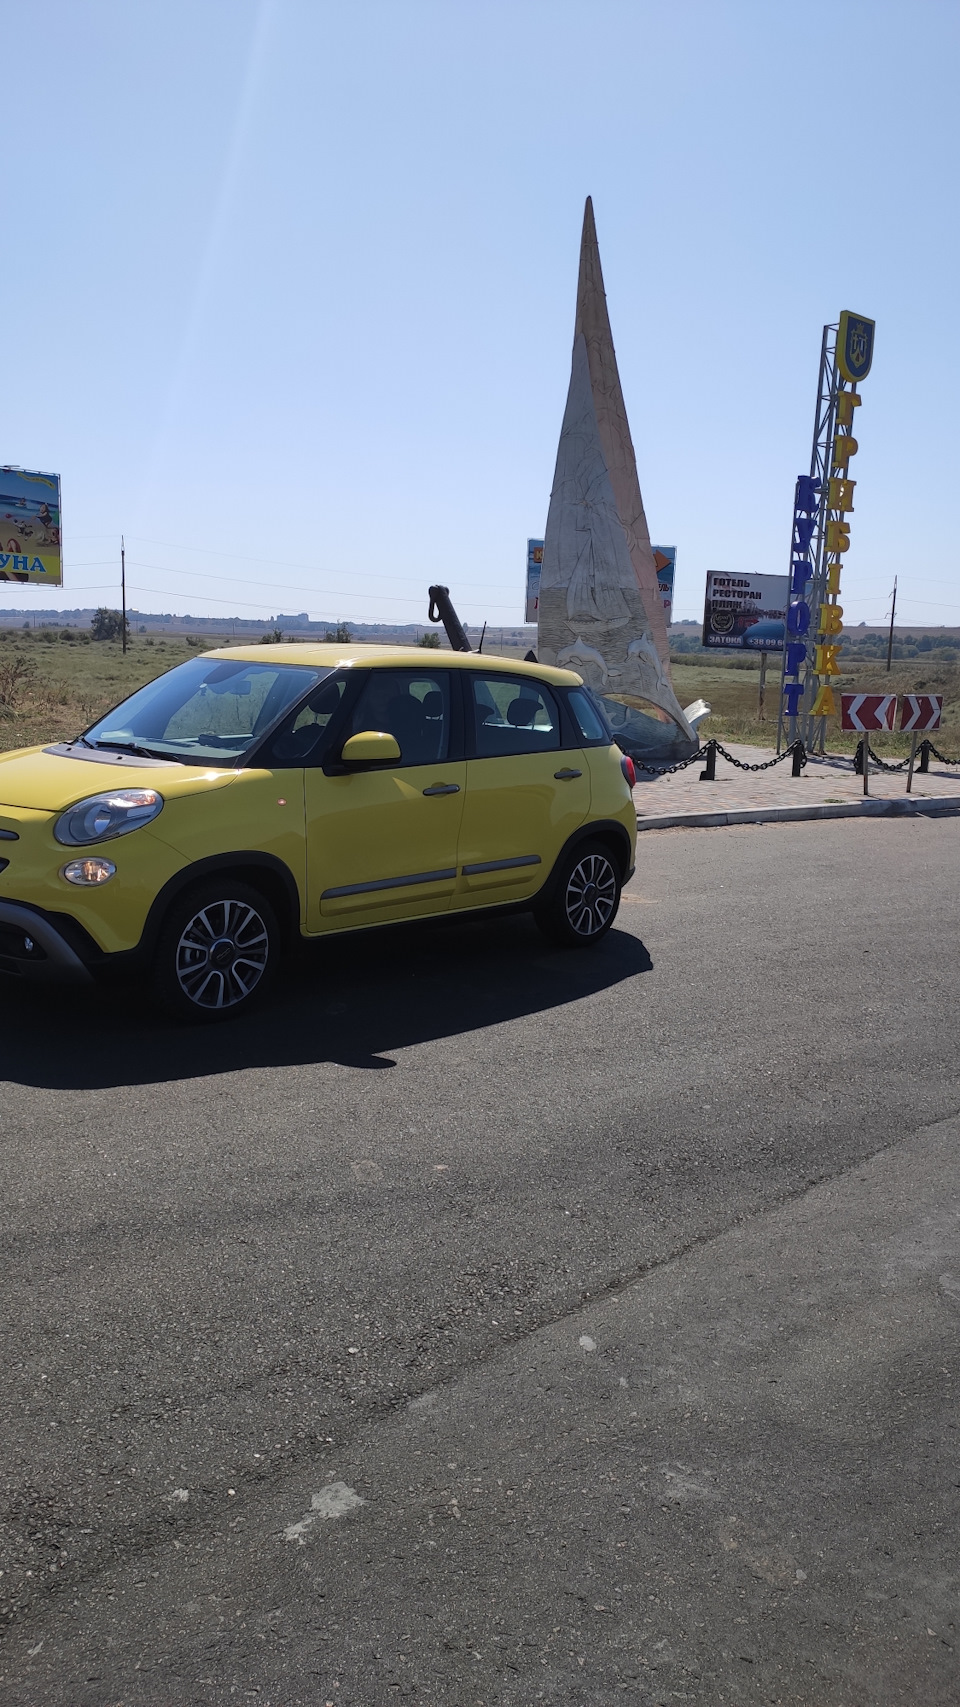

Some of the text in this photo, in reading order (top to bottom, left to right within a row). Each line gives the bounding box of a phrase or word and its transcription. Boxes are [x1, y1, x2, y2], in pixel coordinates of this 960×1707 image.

[809, 391, 862, 716] ГРИБІВКА
[713, 577, 751, 588] ГОТЕЛЬ
[712, 589, 762, 600] РЕСТОРАН
[784, 475, 821, 716] КУРОРТ
[712, 599, 743, 609] ПЛЯЖ
[709, 636, 742, 644] ЗАТОКА
